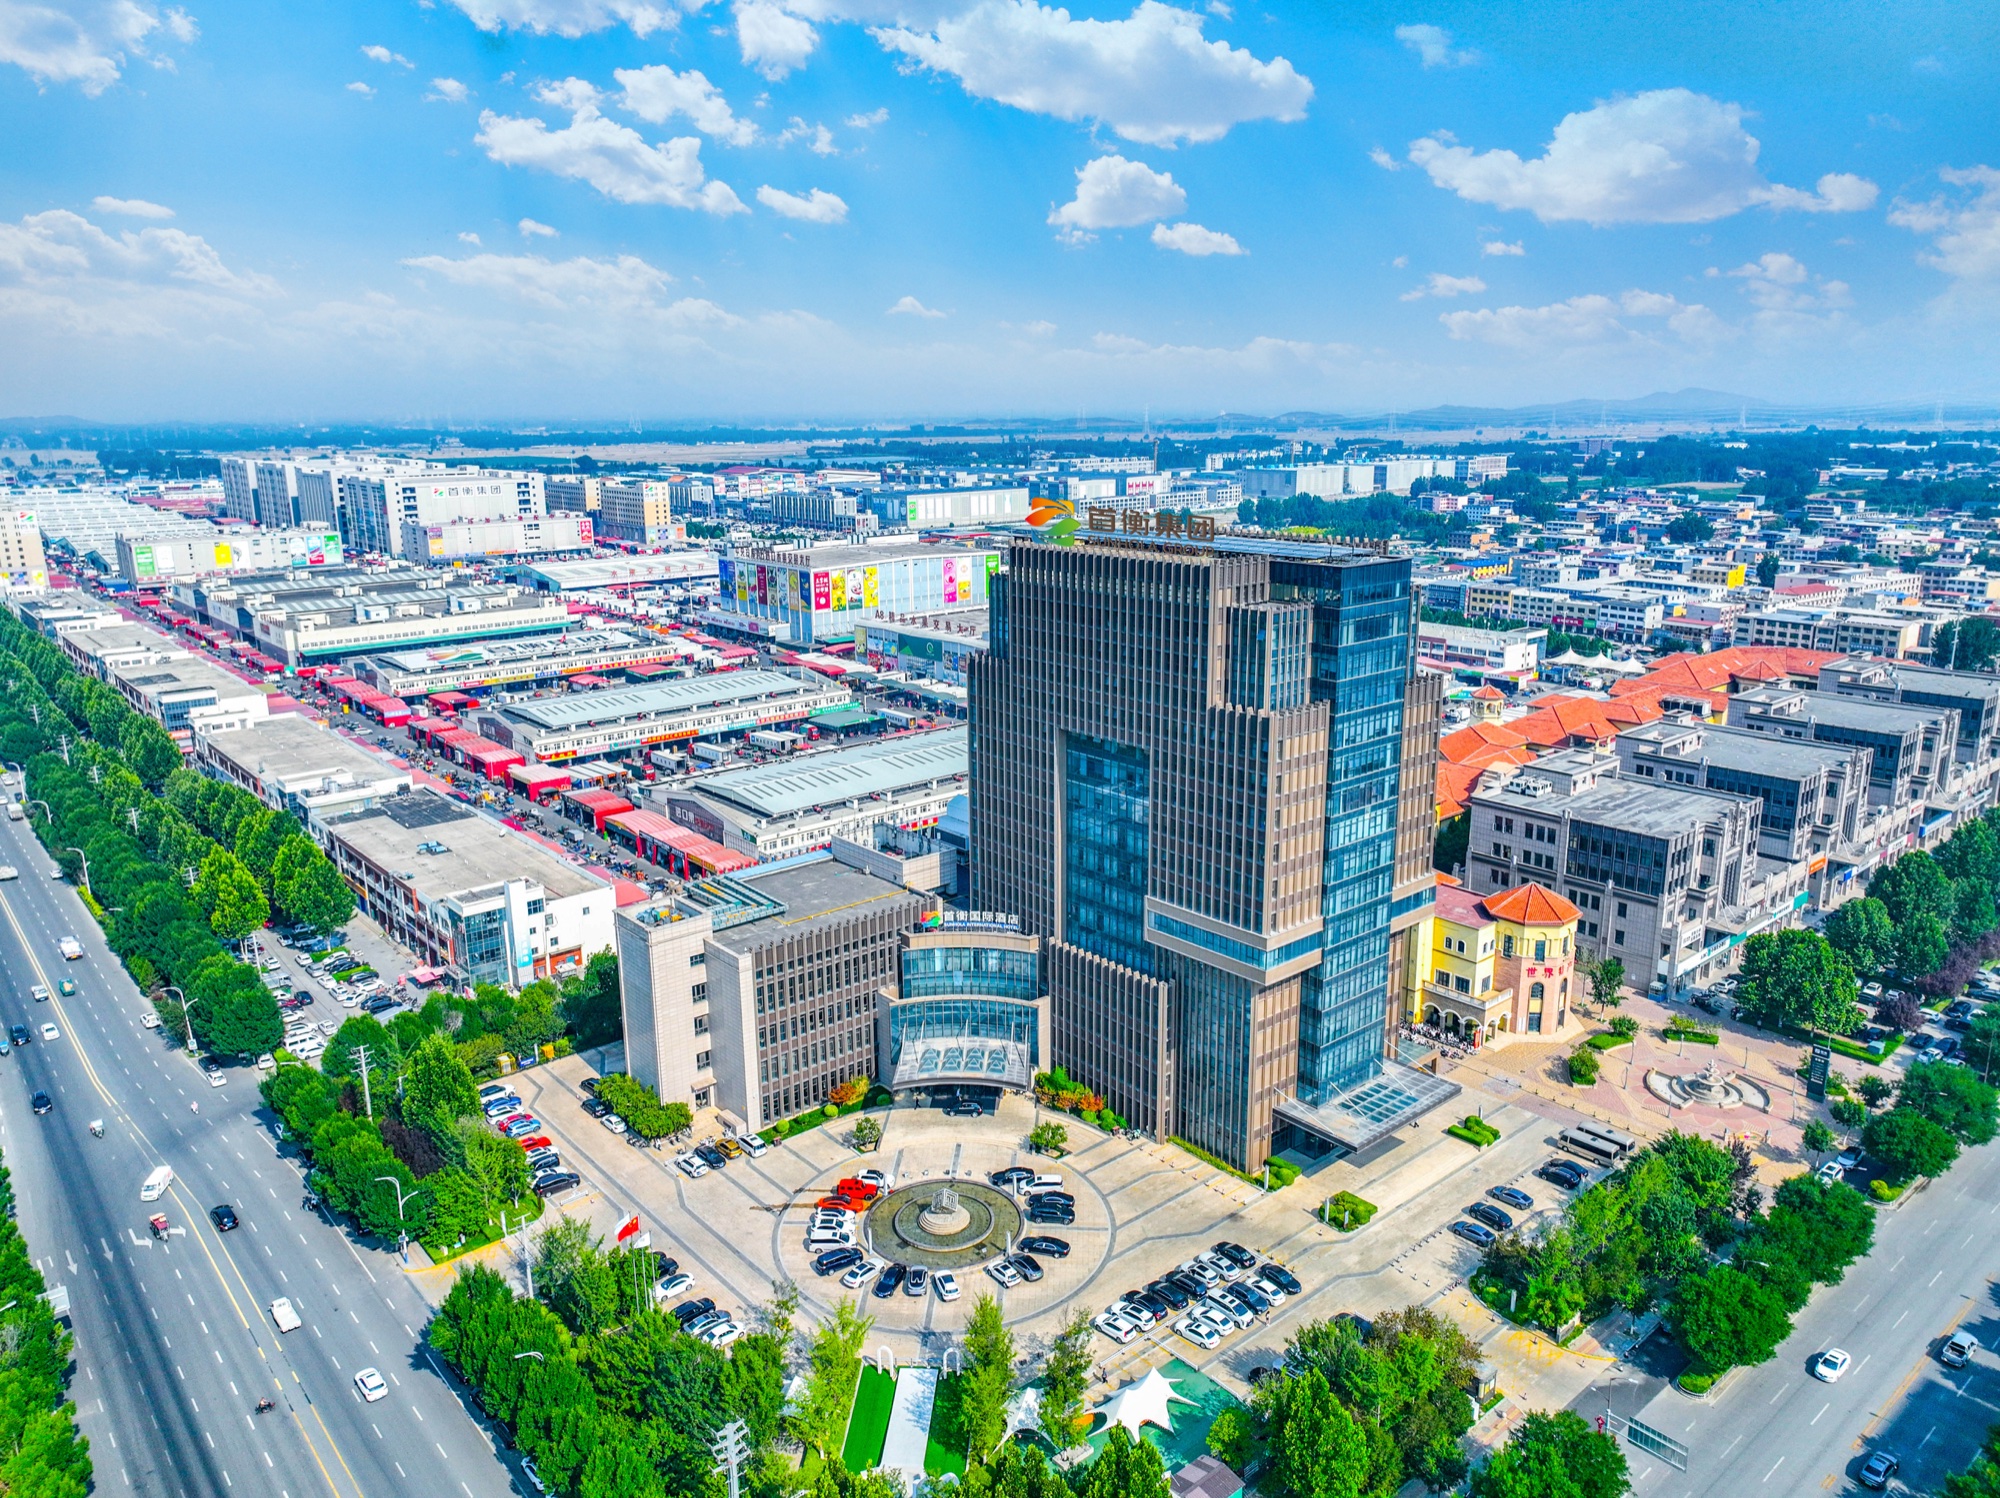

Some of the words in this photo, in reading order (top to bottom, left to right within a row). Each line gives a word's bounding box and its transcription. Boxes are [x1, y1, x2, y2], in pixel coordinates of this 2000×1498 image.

[448, 485, 502, 497] 首衡集团
[1088, 505, 1215, 543] 首衡集团
[1088, 535, 1158, 551] SUNHOLA
[1163, 542, 1215, 557] GROUP
[611, 563, 705, 578] 水果交易大厅
[944, 911, 1018, 924] 首衡国际酒店
